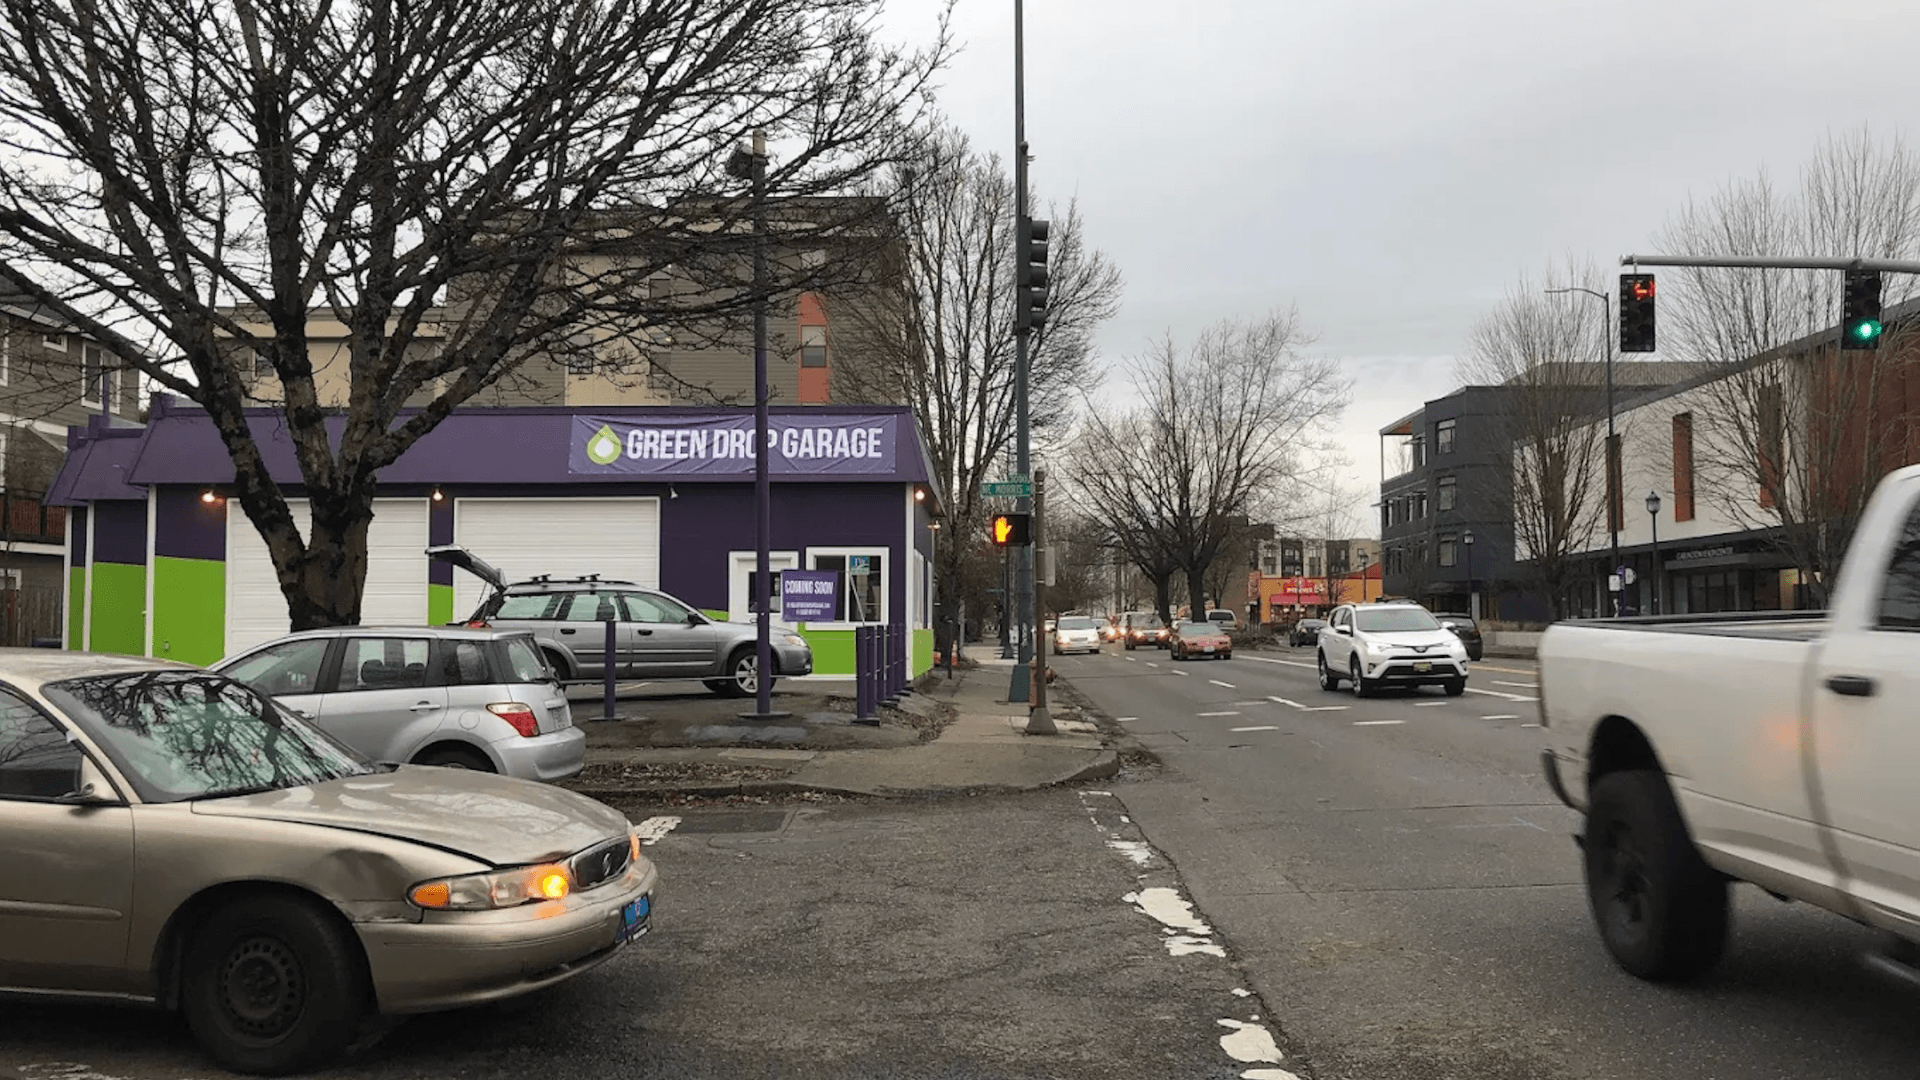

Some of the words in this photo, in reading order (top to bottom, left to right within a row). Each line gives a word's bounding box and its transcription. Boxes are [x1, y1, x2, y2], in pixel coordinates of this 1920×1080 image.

[627, 429, 708, 459] GREEN
[713, 429, 778, 459] DROP
[782, 427, 883, 458] GARAGE
[784, 580, 813, 595] COMING
[814, 581, 834, 596] SOON
